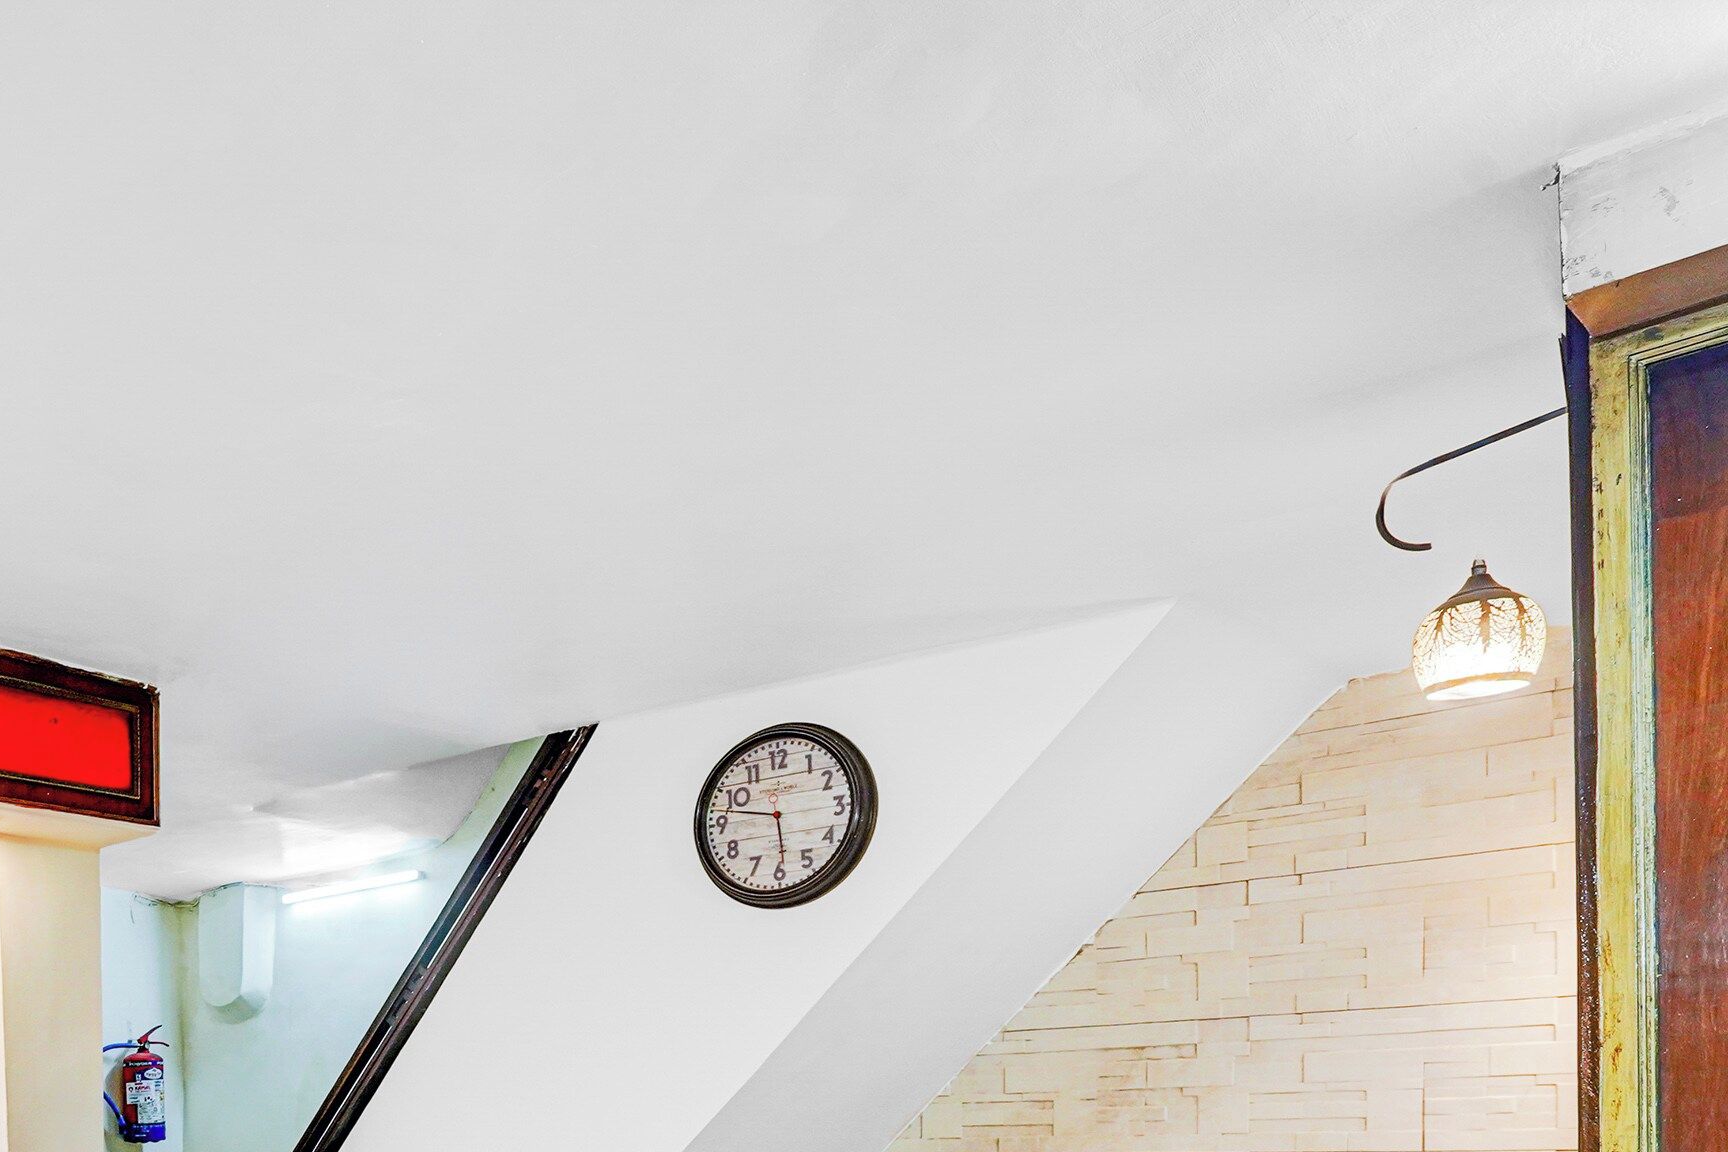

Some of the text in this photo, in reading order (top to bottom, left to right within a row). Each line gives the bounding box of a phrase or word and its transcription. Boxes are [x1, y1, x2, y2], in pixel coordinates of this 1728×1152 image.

[769, 749, 788, 770] 12
[805, 755, 813, 774] 1
[745, 764, 760, 784] 11
[821, 770, 833, 791] 2
[726, 787, 751, 809] 10
[833, 795, 846, 816] 3
[716, 815, 728, 835] 9
[822, 824, 835, 844] 4
[727, 839, 739, 859] 8
[800, 849, 813, 869] 5
[749, 855, 762, 876] 7
[773, 861, 786, 881] 6
